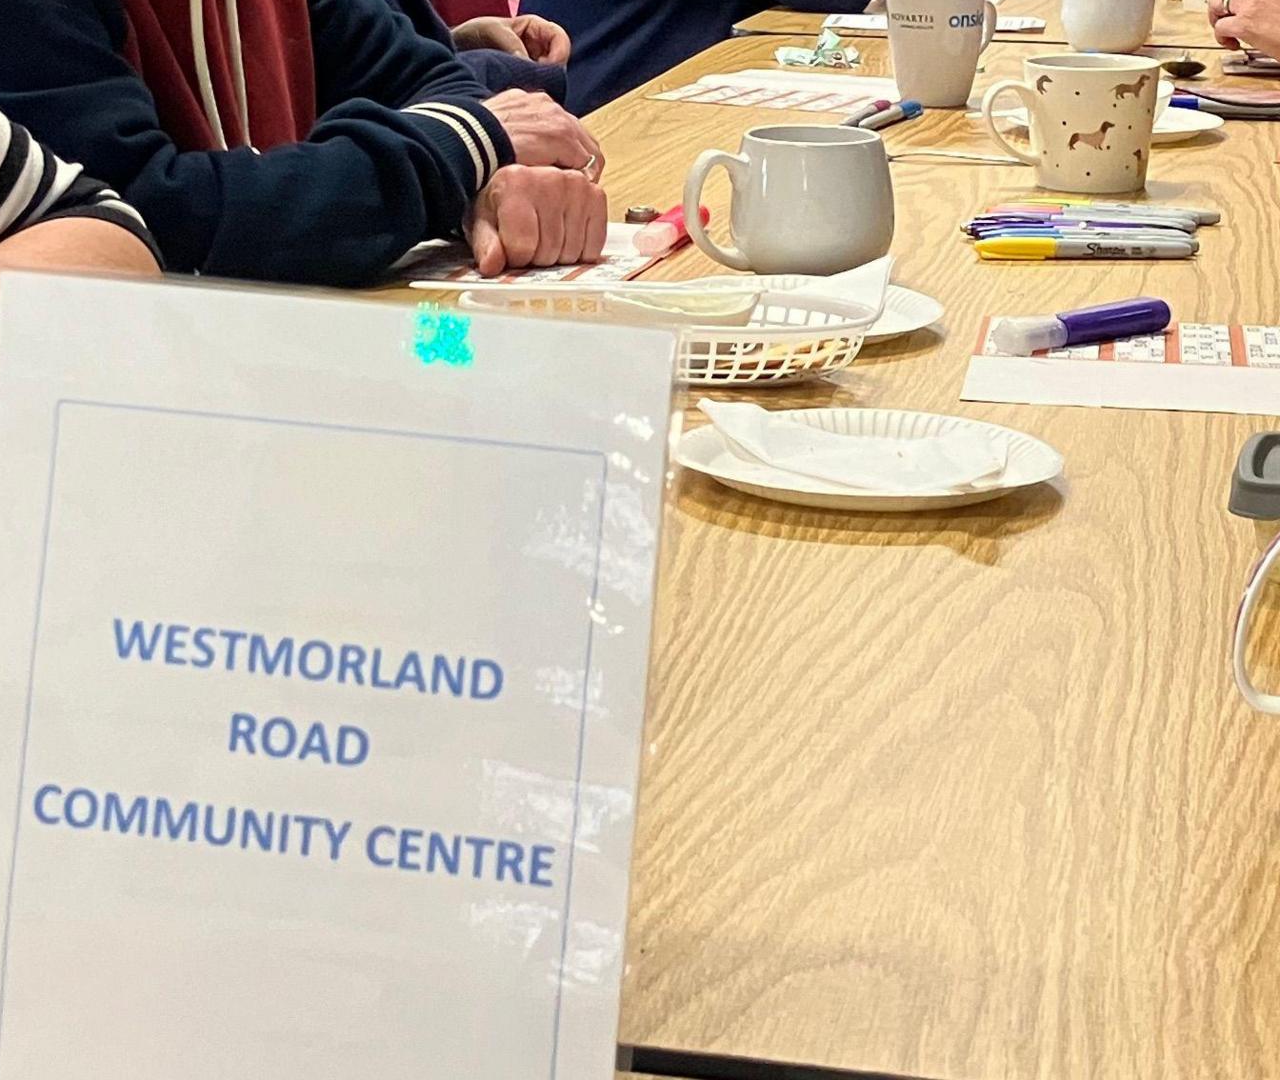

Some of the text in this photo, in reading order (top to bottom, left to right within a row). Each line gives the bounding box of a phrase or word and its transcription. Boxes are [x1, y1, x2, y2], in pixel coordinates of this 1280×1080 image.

[113, 618, 506, 701] WESTMORLAND
[228, 712, 370, 767] ROAD
[32, 784, 556, 887] COMMUNITY CENTRE
